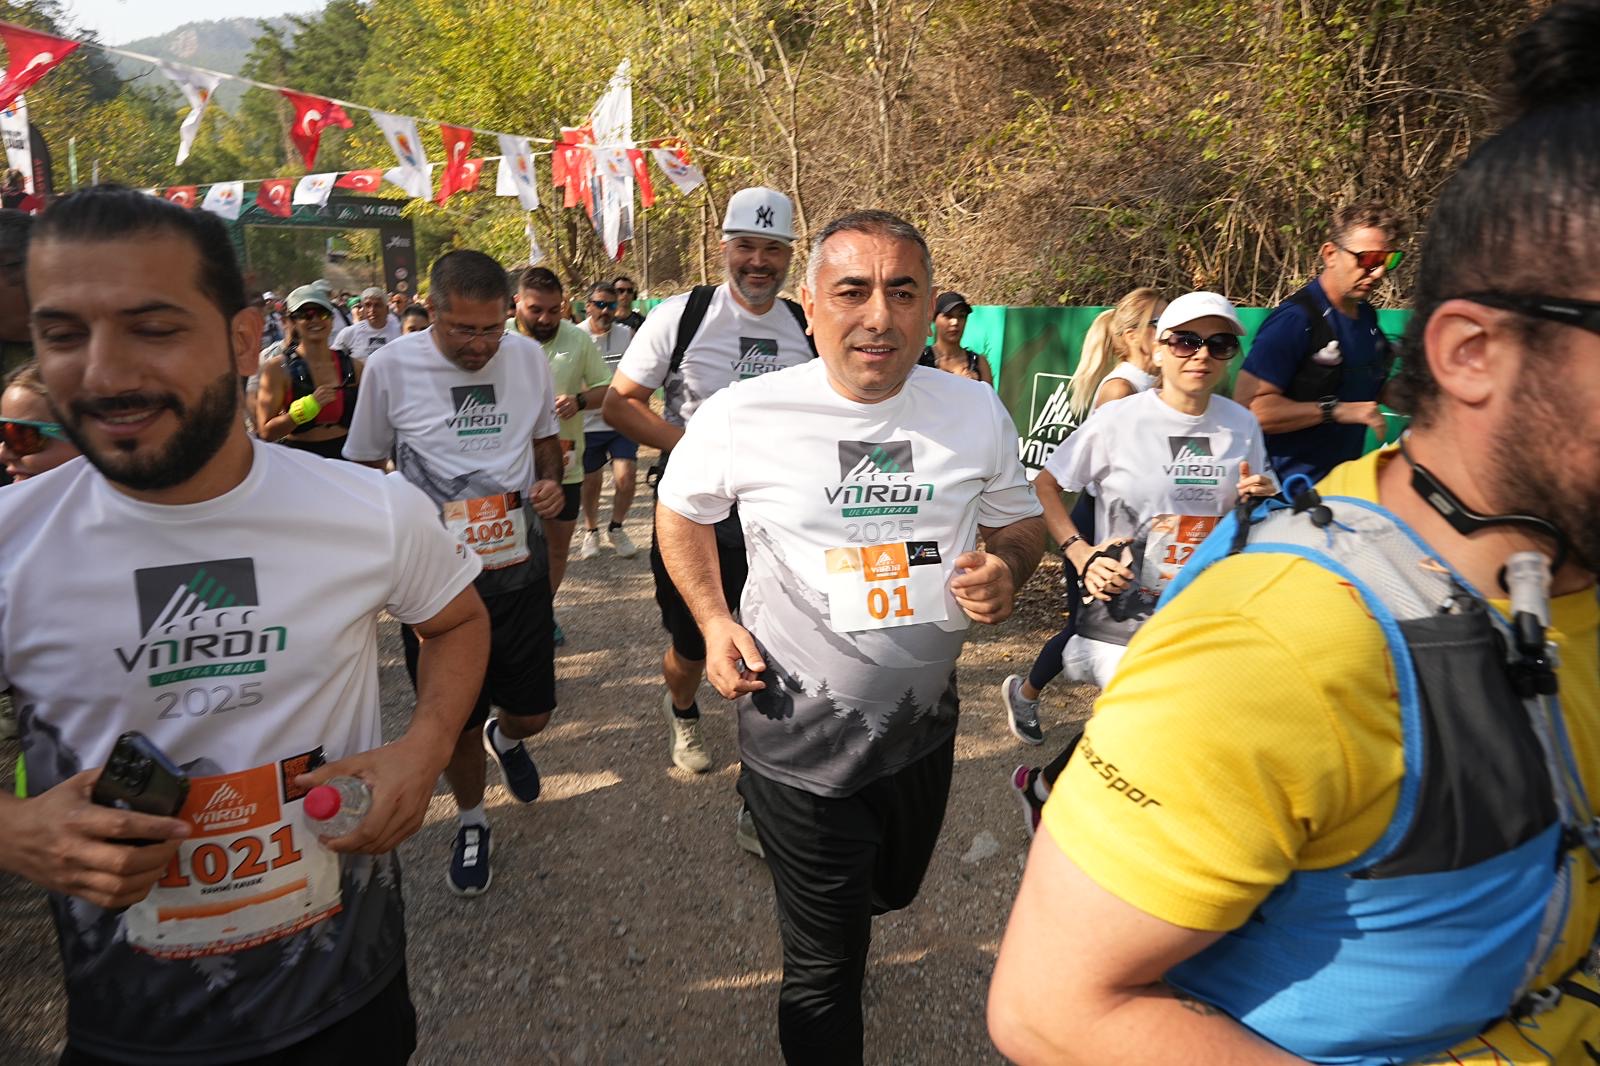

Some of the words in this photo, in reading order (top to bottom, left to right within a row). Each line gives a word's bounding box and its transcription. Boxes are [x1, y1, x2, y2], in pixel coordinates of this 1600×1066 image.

[755, 205, 774, 228] NY
[459, 437, 501, 453] 2025
[1174, 487, 1216, 502] 2025
[848, 507, 881, 517] ULTRA
[882, 505, 913, 515] TRAIL
[464, 519, 514, 545] 1002
[844, 519, 915, 544] 2025
[1163, 544, 1195, 566] 12
[867, 585, 915, 620] 01
[159, 666, 211, 684] ULTRA
[213, 661, 258, 676] TRAIL
[154, 681, 265, 721] 2025
[158, 824, 303, 888] 1021
